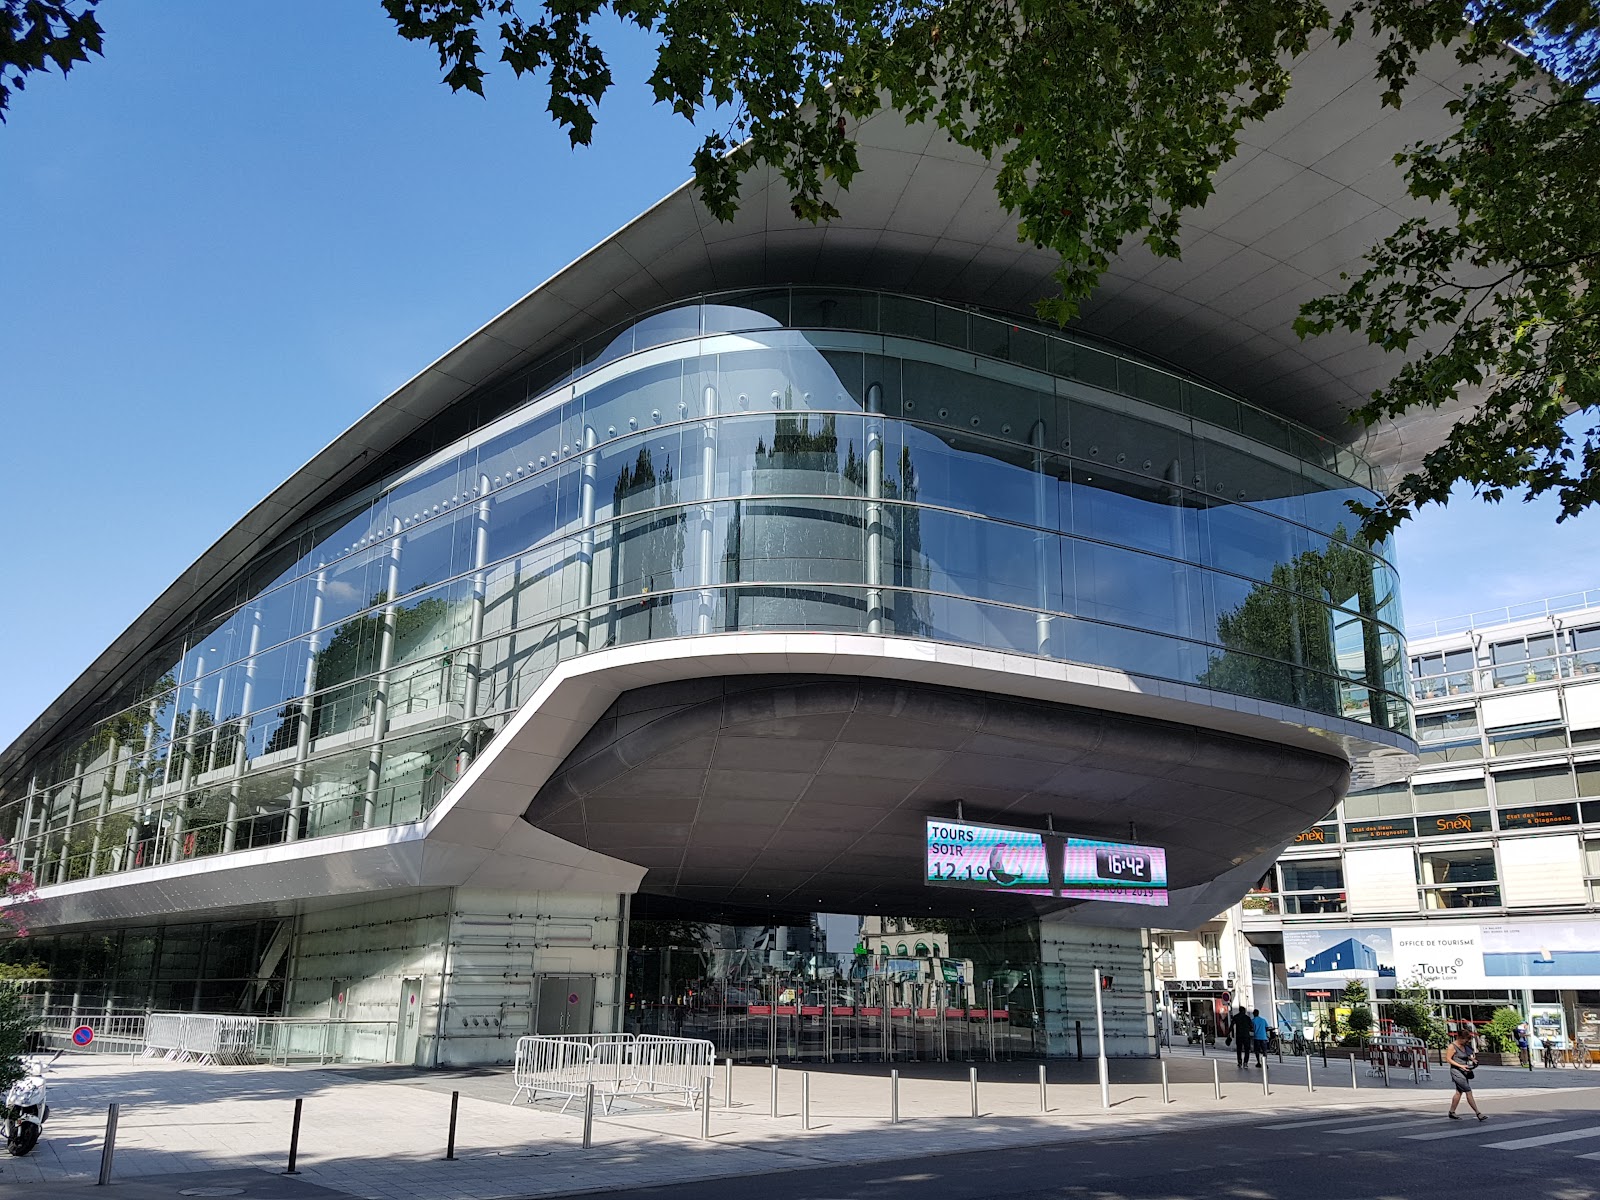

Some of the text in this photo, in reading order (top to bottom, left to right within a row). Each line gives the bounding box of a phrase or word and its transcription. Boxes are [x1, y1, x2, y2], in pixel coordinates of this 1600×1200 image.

[1534, 816, 1571, 824] Diagnostic
[932, 827, 974, 842] TOURS
[1376, 829, 1409, 837] Diagnostic
[932, 843, 963, 857] SOIR
[1108, 854, 1144, 877] 16:42
[1418, 963, 1457, 975] Tours
